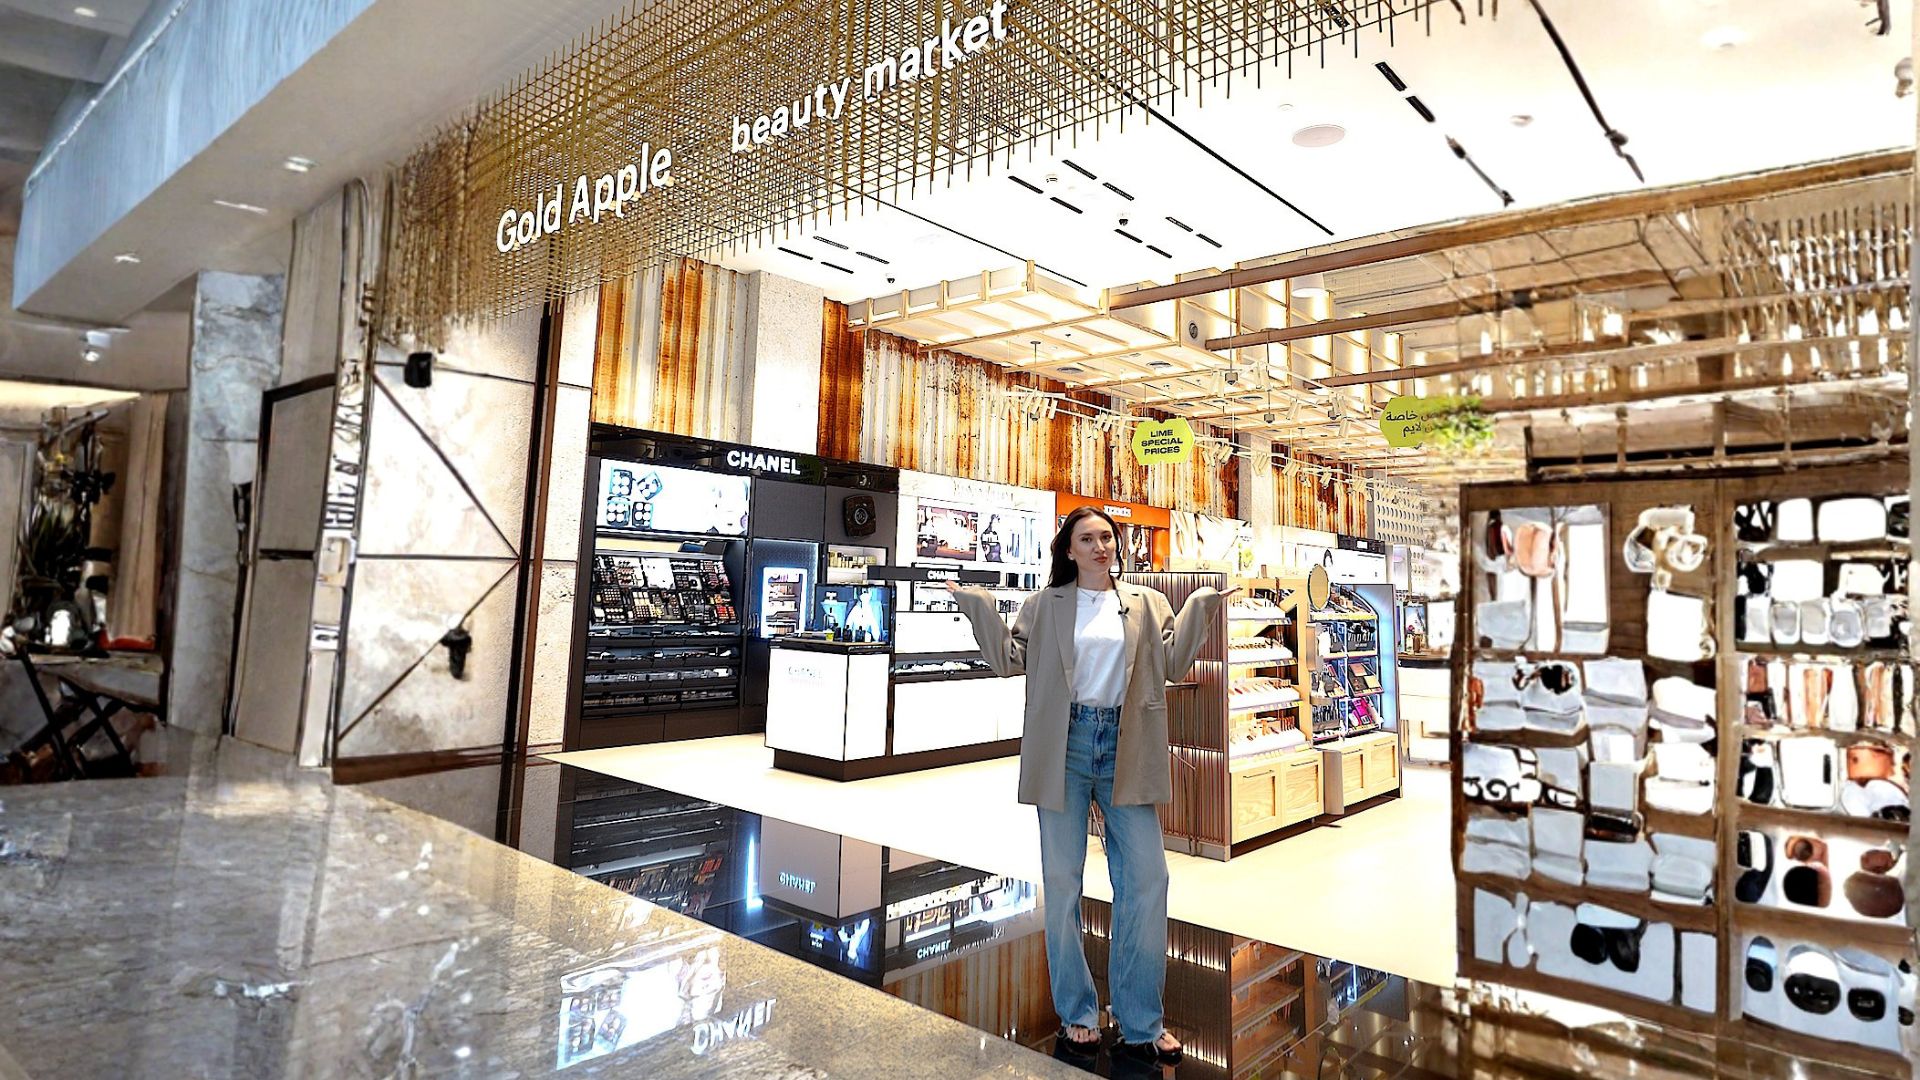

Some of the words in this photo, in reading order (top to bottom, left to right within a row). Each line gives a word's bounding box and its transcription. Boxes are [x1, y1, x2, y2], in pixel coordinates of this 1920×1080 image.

[496, 182, 563, 253] Gold
[568, 142, 672, 224] Apple
[731, 77, 851, 153] beauty
[864, 0, 1008, 100] market
[1385, 410, 1418, 422] خاصة
[1150, 429, 1173, 437] LIME
[1403, 421, 1422, 438] لايم
[1141, 438, 1183, 447] SPECIAL
[1144, 446, 1181, 455] PRICES
[726, 450, 801, 475] CHANEL
[927, 570, 961, 581] CHANEL
